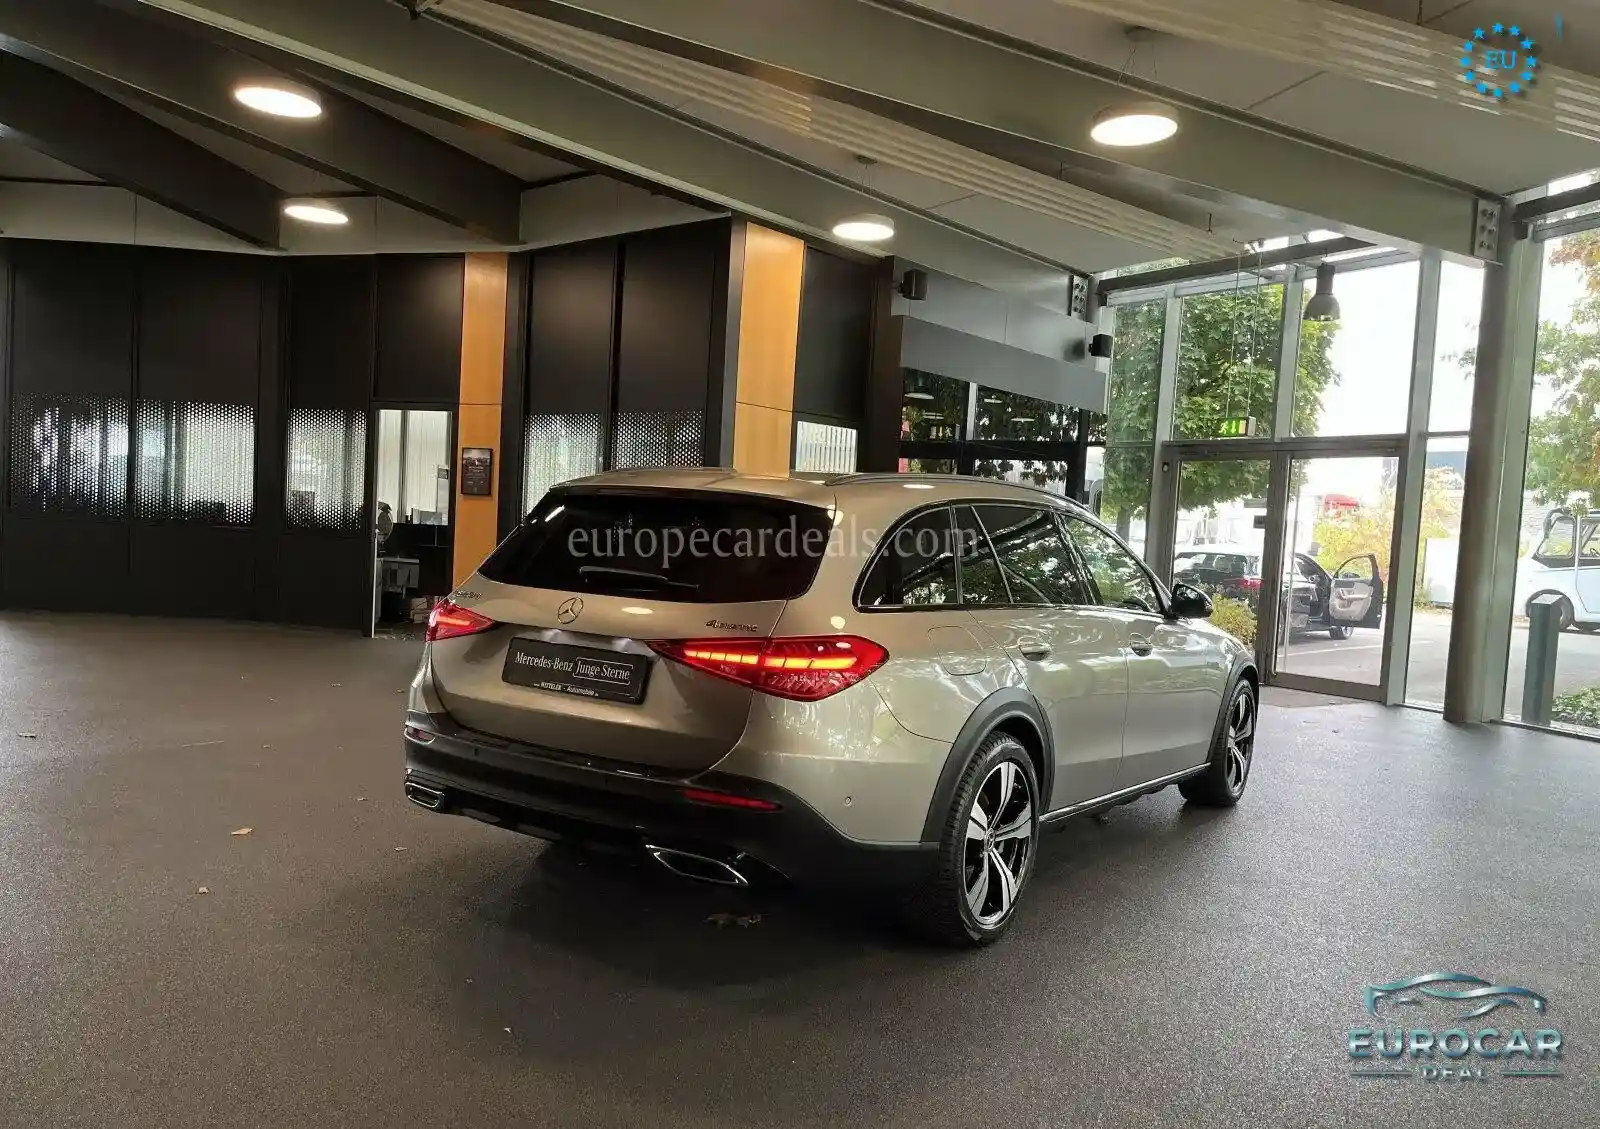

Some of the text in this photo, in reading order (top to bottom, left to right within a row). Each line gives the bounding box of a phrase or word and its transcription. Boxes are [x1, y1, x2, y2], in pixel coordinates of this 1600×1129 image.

[515, 651, 630, 680] Mercedes-Benz Junge Sterne
